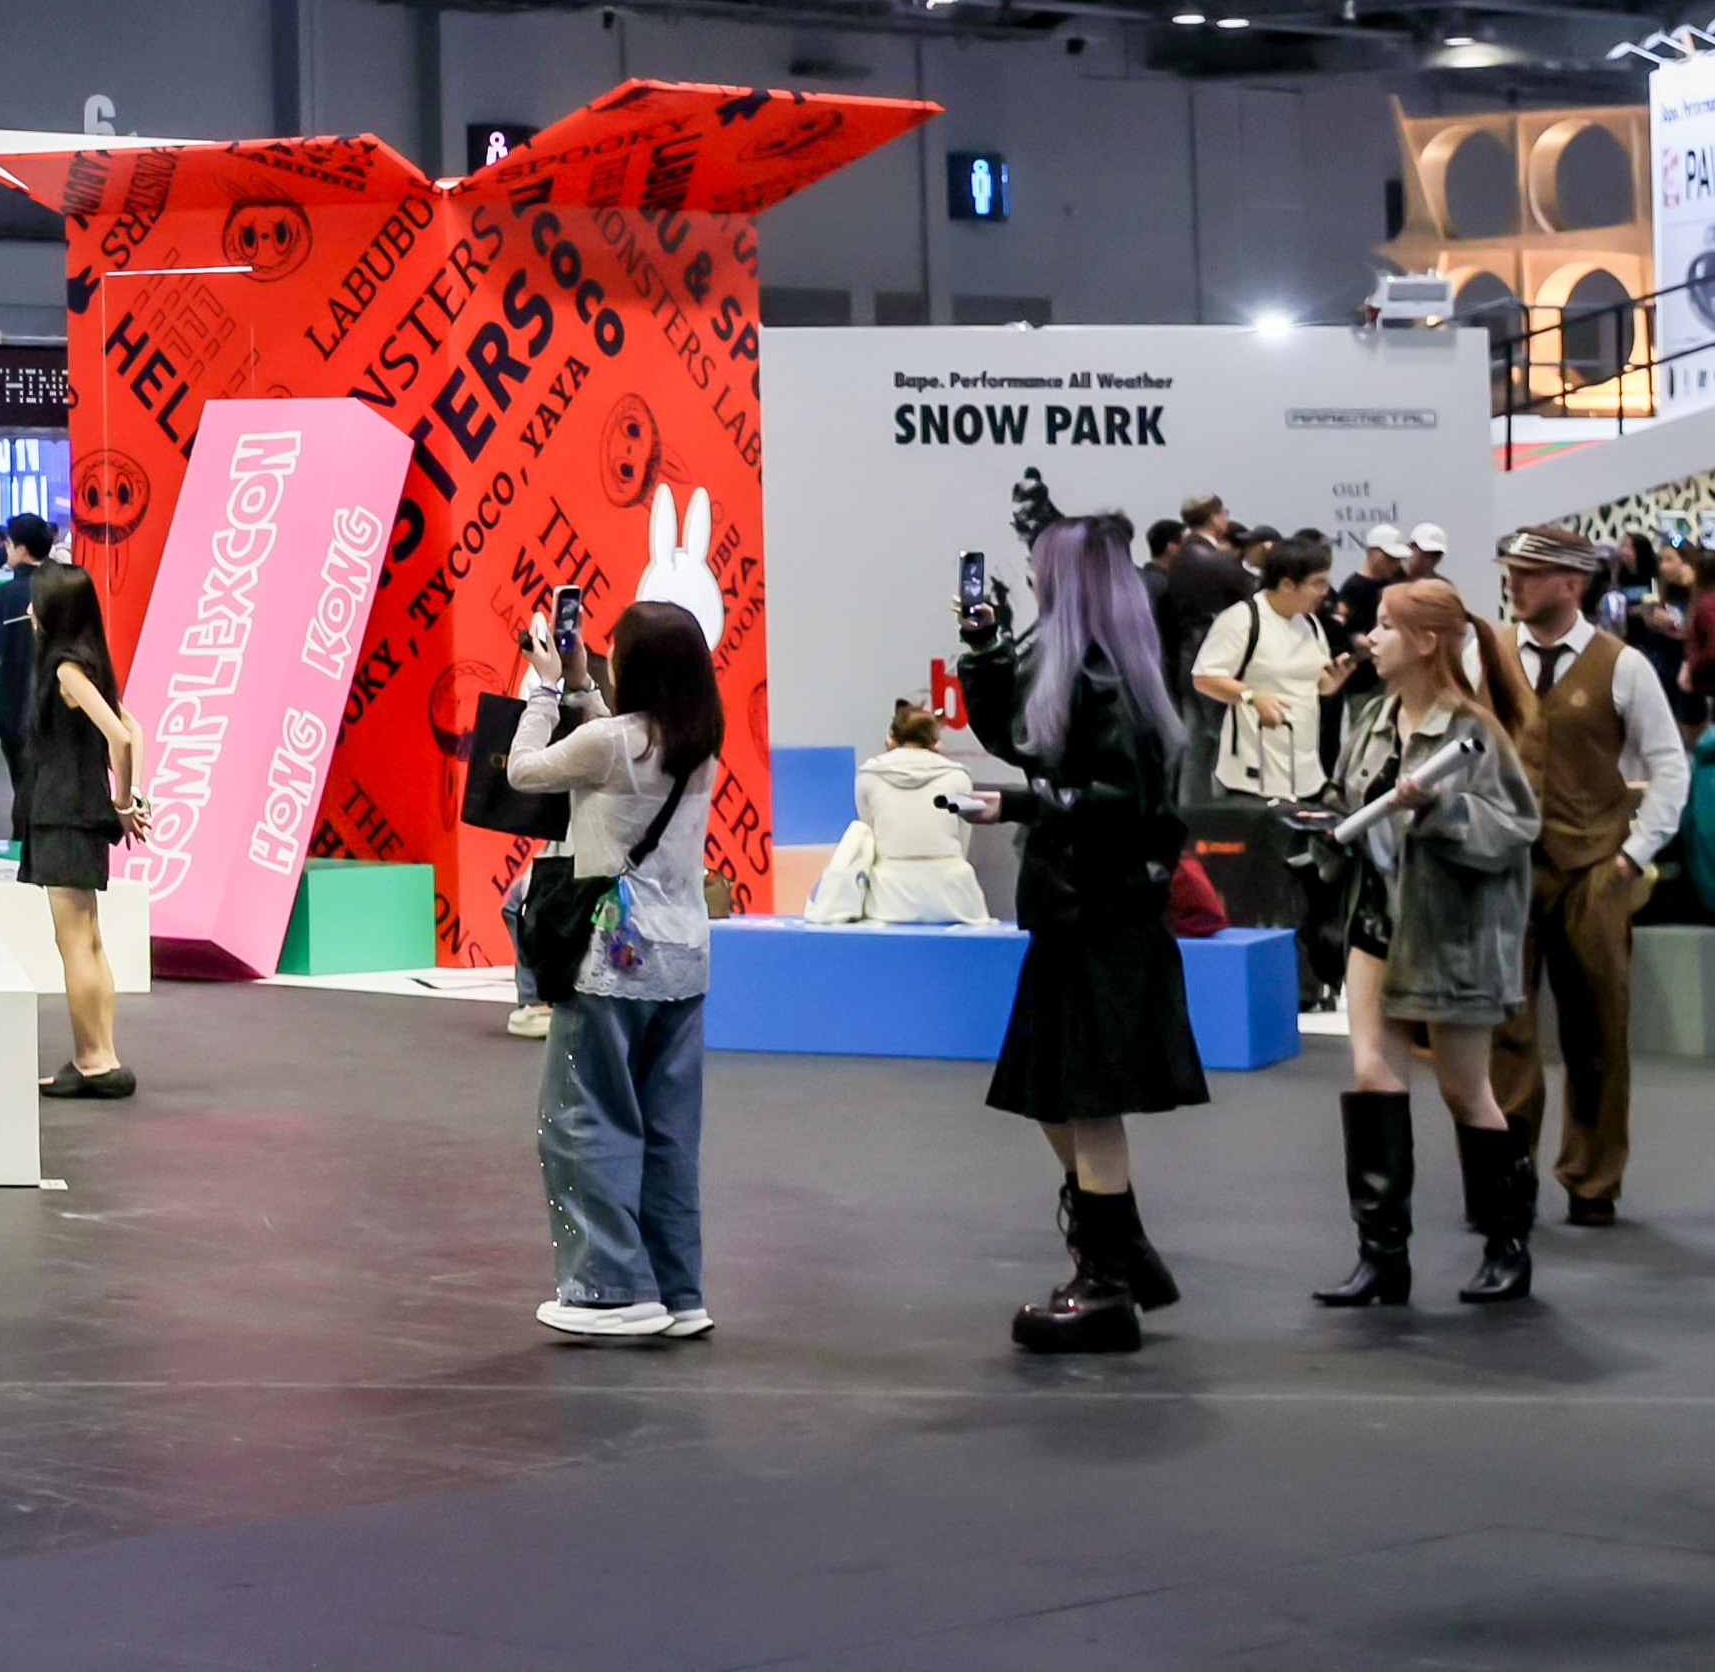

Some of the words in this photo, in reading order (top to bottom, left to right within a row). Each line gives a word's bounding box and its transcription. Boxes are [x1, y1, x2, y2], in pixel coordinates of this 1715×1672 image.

[304, 190, 434, 362] LABUBU
[347, 204, 504, 409] NSTERS
[102, 311, 197, 462] HEL
[520, 355, 591, 459] YAYA
[894, 371, 945, 393] Bape.
[949, 370, 1064, 389] Performance
[1068, 371, 1092, 389] All
[1096, 370, 1174, 389] Weather
[894, 403, 1029, 446] SNOW
[1045, 404, 1167, 446] PARK
[1332, 481, 1370, 498] out
[1334, 500, 1399, 522] stand
[124, 430, 303, 903] COMPLEXCON
[248, 707, 328, 876] HONG
[301, 505, 383, 681] KONG
[712, 762, 773, 877] ERS
